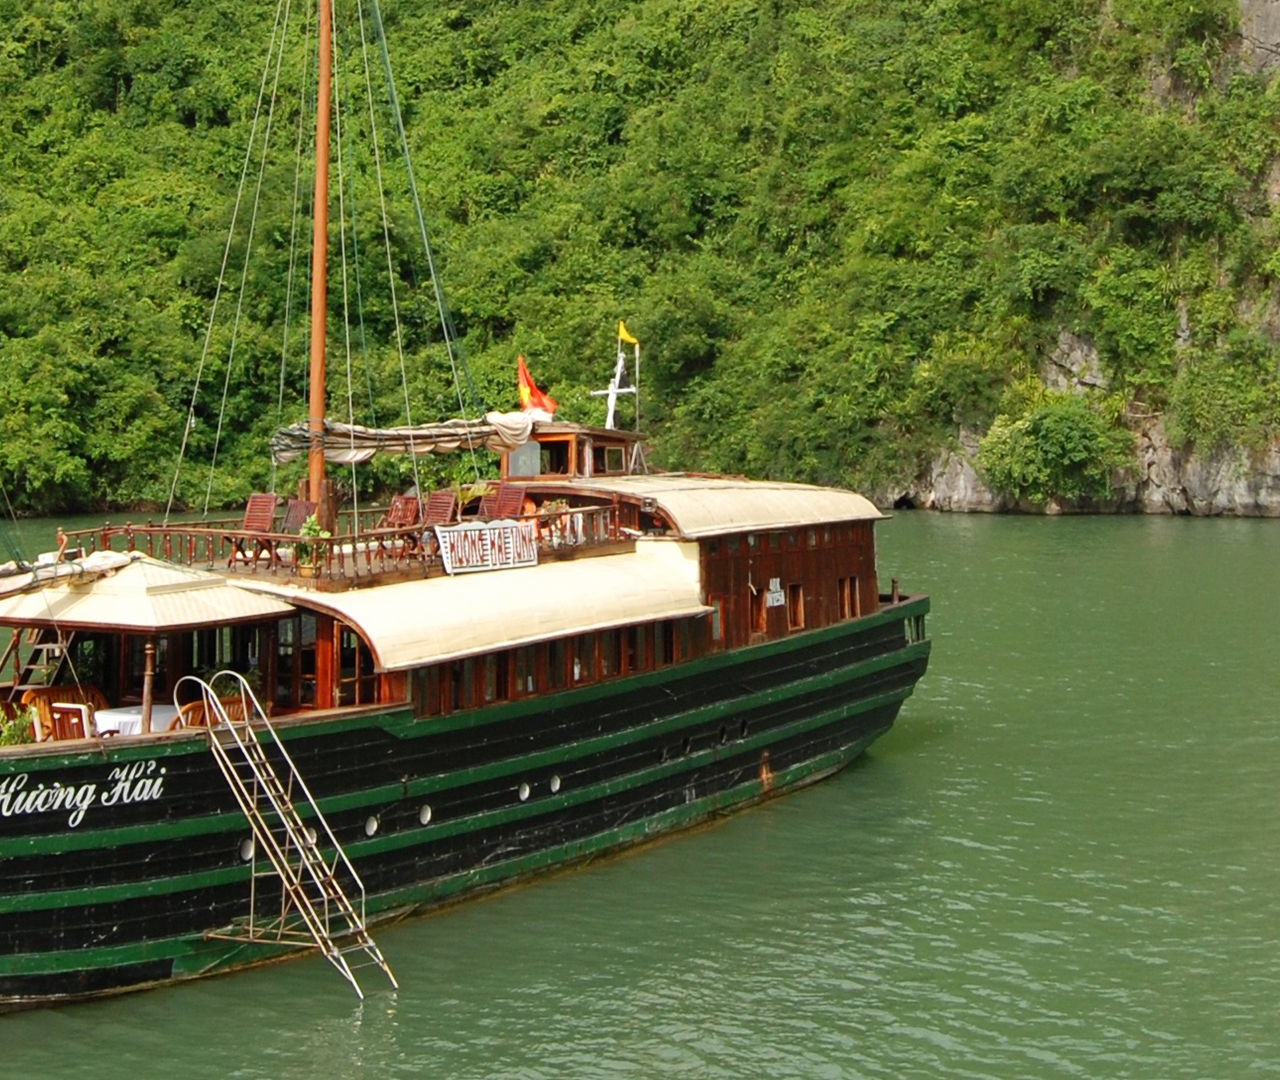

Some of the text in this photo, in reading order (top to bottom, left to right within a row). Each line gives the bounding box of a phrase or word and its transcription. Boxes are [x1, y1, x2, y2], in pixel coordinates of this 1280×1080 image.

[449, 530, 485, 567] HUONG
[489, 528, 507, 564] HAI
[101, 760, 166, 806] Hải
